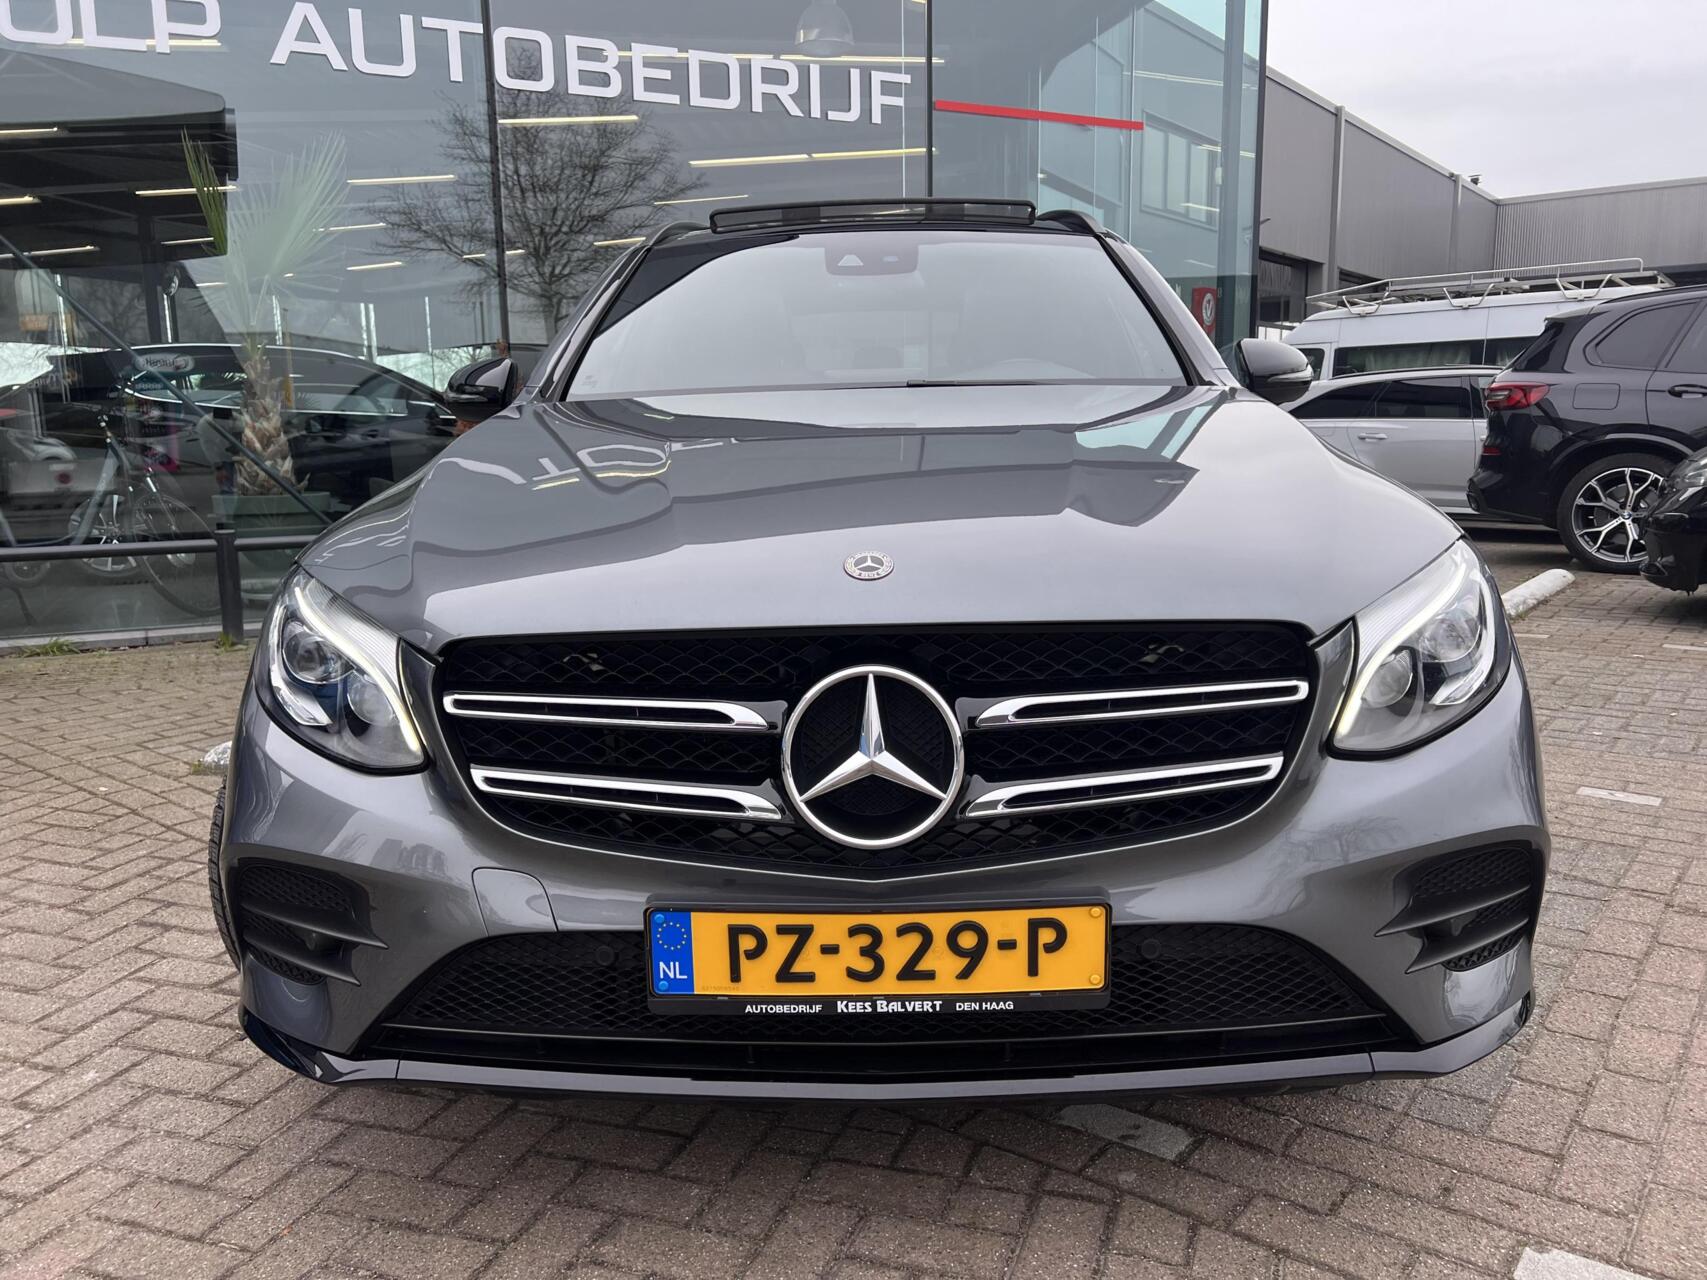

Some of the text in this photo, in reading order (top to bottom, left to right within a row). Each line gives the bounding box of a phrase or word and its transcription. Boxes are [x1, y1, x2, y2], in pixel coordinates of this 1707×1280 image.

[269, 1, 912, 125] AUTOBEDRIJF
[659, 961, 688, 980] NL
[727, 917, 1068, 984] PZ-329-P
[744, 1004, 823, 1014] AUTOBEDRIJF
[955, 1002, 980, 1012] DEN
[982, 1001, 1015, 1011] HAAG
